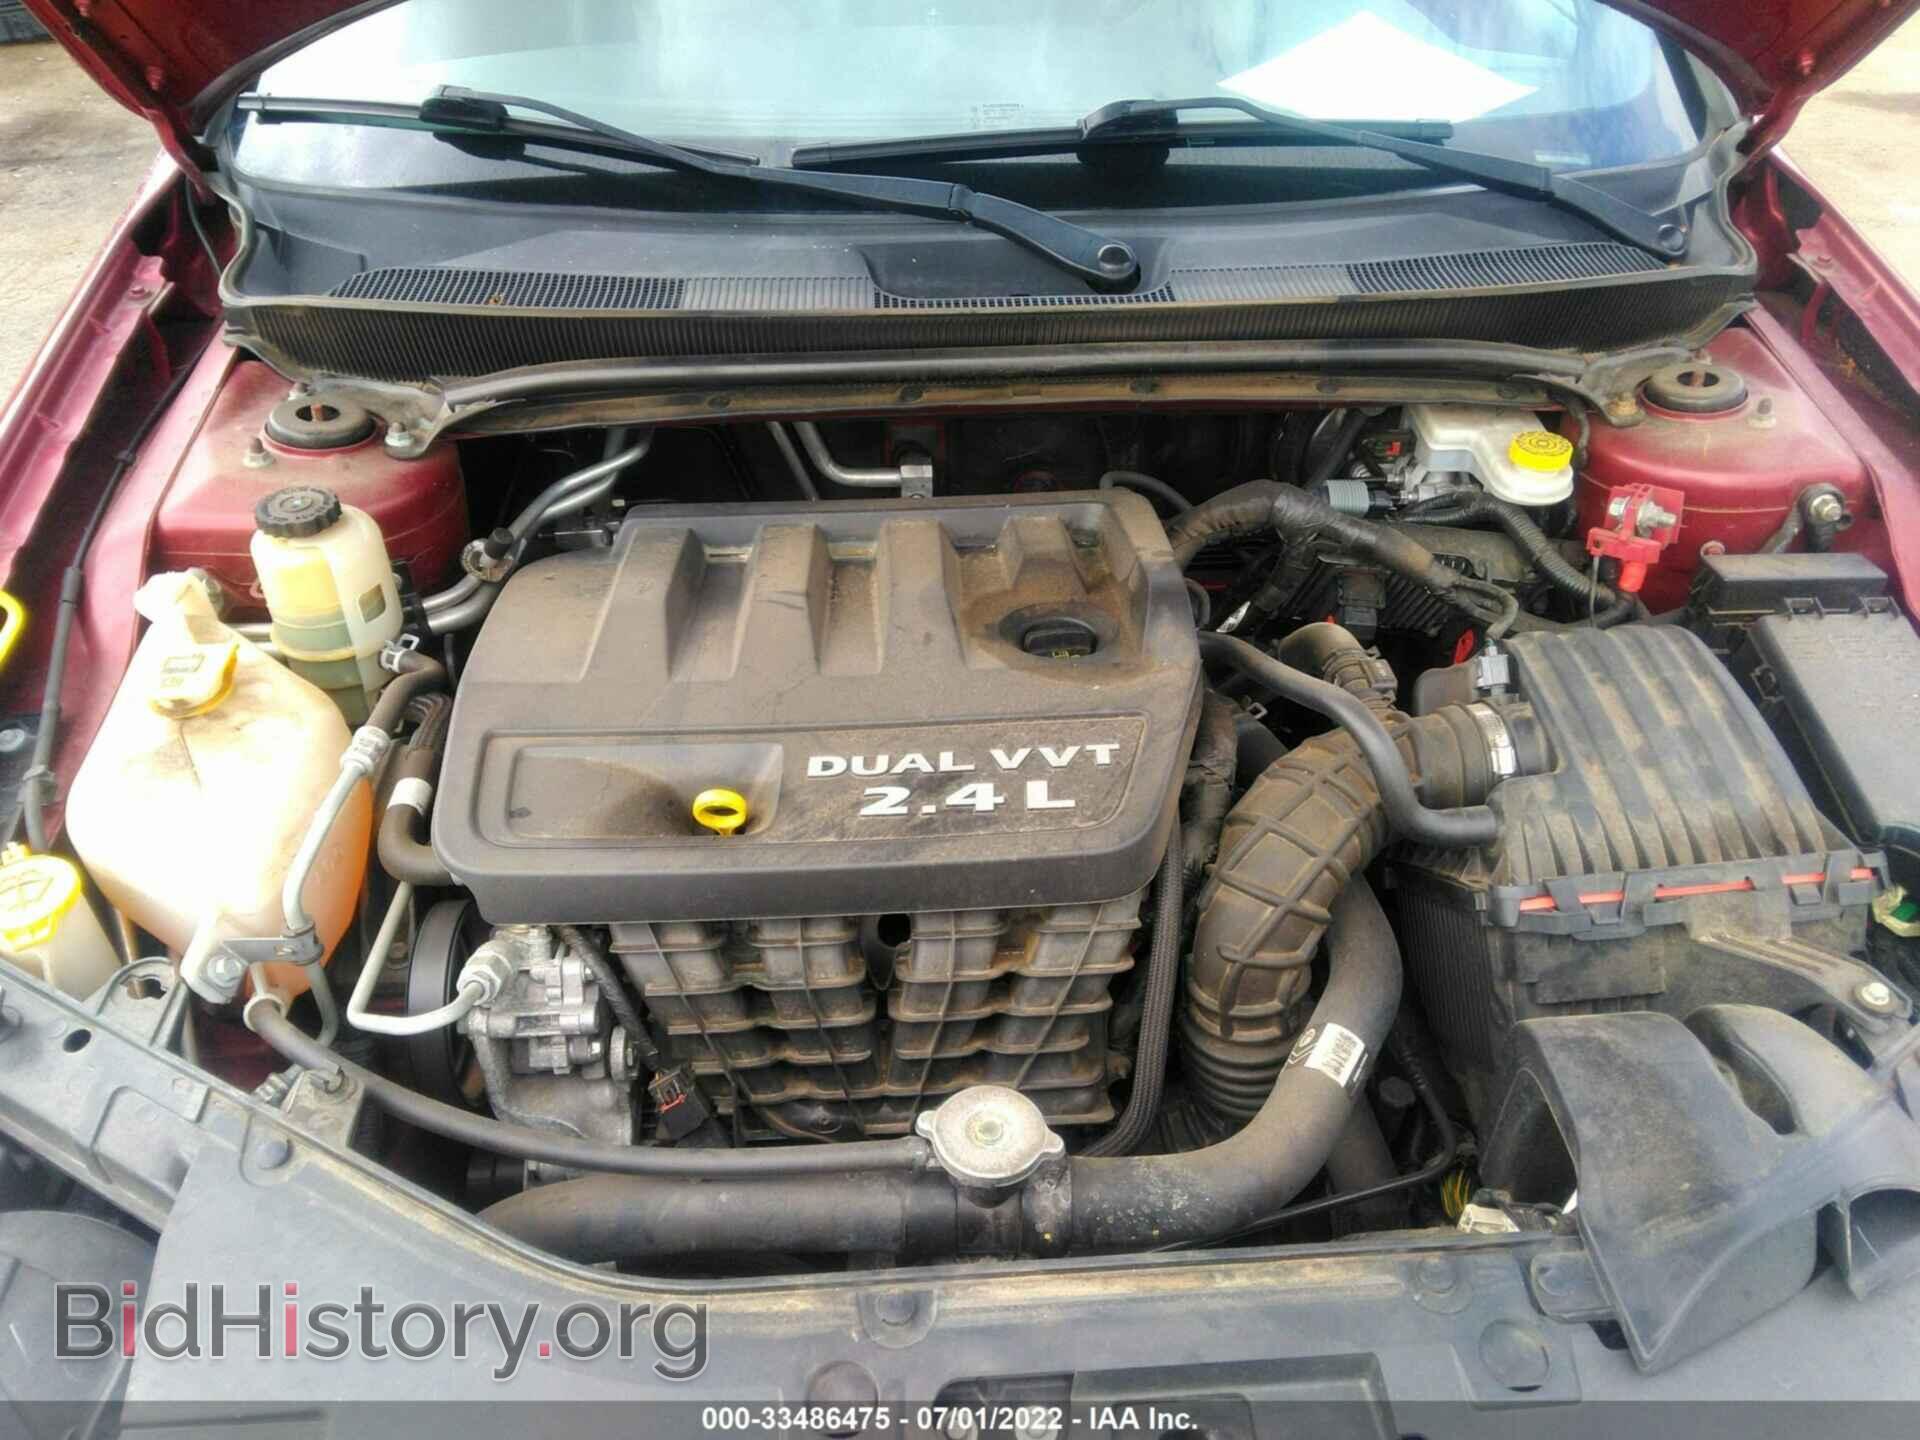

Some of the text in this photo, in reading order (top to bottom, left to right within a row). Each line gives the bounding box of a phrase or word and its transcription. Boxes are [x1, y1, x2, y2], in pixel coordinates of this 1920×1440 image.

[807, 743, 1121, 777] DUAL VVT
[859, 780, 1077, 816] 2.4 L
